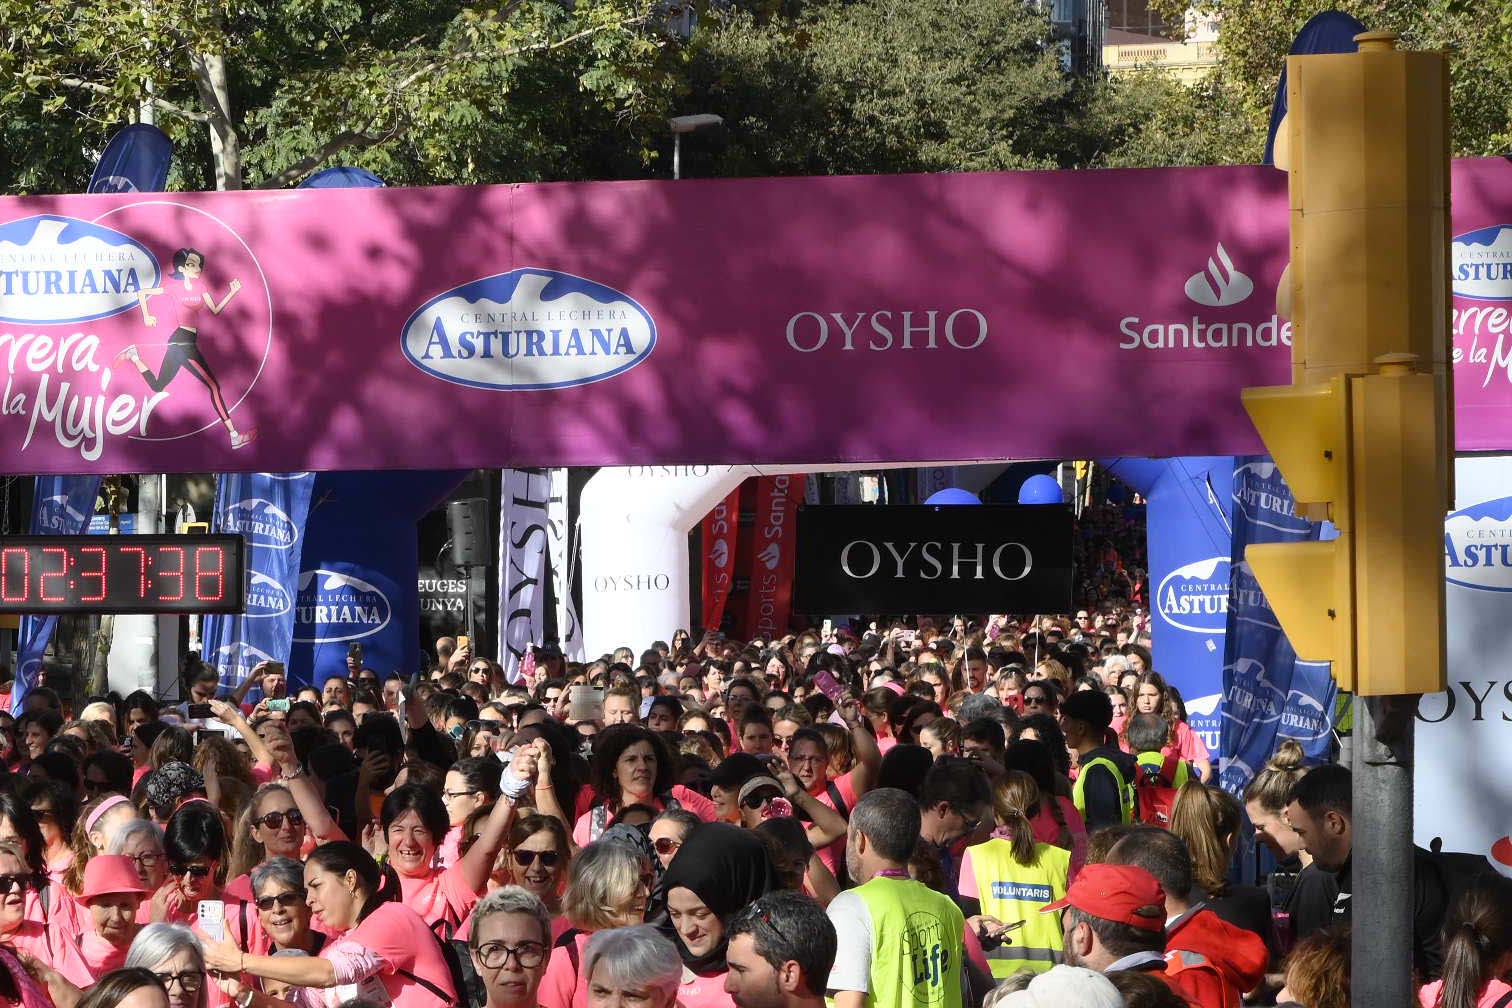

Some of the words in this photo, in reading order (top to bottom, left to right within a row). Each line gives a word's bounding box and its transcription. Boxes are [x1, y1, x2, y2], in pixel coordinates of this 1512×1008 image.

[460, 311, 539, 323] CENTRAL
[547, 309, 628, 322] LECHERA
[785, 308, 988, 352] OYSHO
[1120, 315, 1292, 350] Santande
[421, 316, 636, 359] ASTURIANA
[1469, 336, 1487, 363] la
[1, 375, 26, 416] la
[22, 367, 170, 461] Mujer
[1, 546, 224, 602] 02:37:38
[506, 468, 548, 661] OYSH
[841, 540, 1033, 581] OYSHO
[418, 579, 467, 592] EUGES
[594, 573, 670, 592] OYSHO
[295, 606, 381, 625] TURIANA
[993, 886, 1050, 899] VOLUNTARIS
[912, 943, 949, 988] Life
